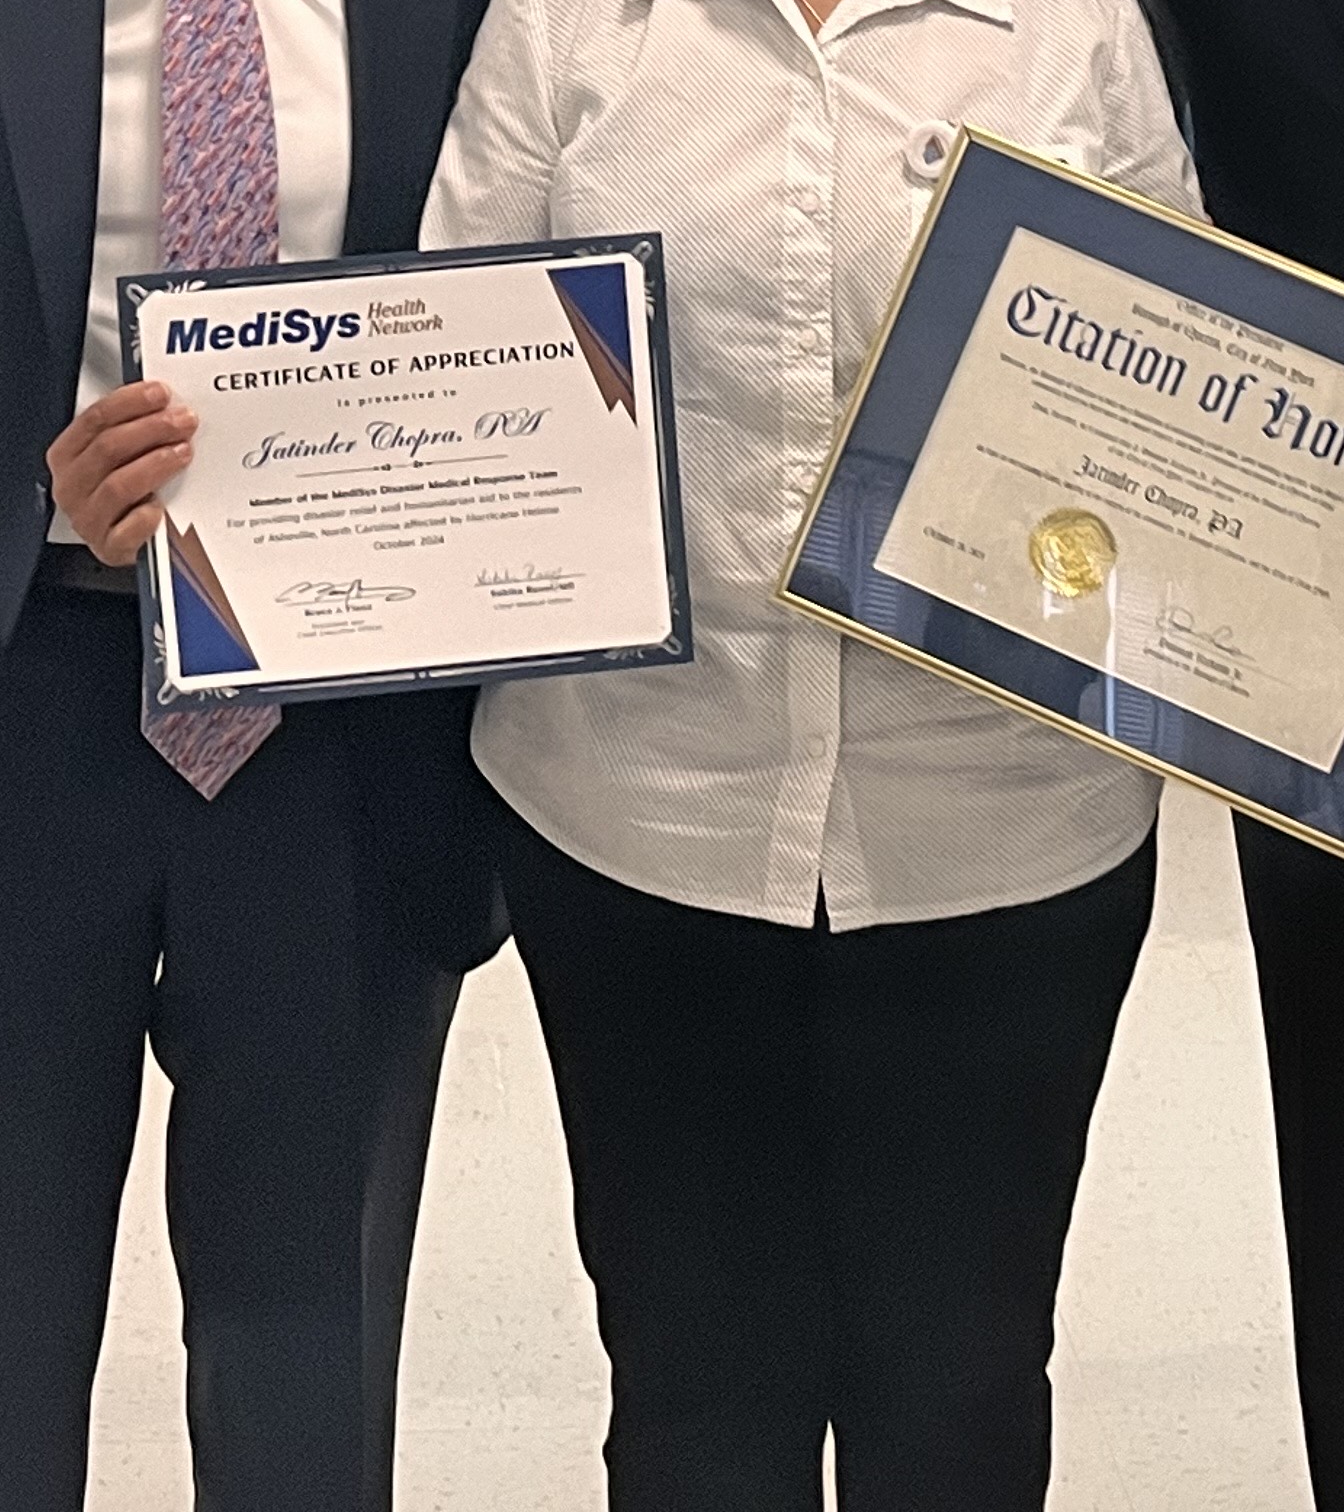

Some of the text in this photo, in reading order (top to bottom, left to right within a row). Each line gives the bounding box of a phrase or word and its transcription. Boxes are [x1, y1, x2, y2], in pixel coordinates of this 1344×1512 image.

[367, 298, 425, 320] Health
[367, 314, 443, 337] Network
[166, 309, 360, 354] MediSys
[214, 342, 573, 391] CERTIFICATE OF APPRECIATION
[1006, 284, 1188, 397] Citation
[1198, 373, 1259, 424] of
[358, 391, 434, 407] presented
[442, 389, 457, 398] to
[242, 431, 357, 471] Jatinder
[474, 407, 552, 440] PA
[296, 493, 308, 504] of
[331, 487, 378, 500] MediSys
[379, 483, 425, 495] Disaster
[427, 476, 471, 489] Medical
[528, 471, 558, 480] Team
